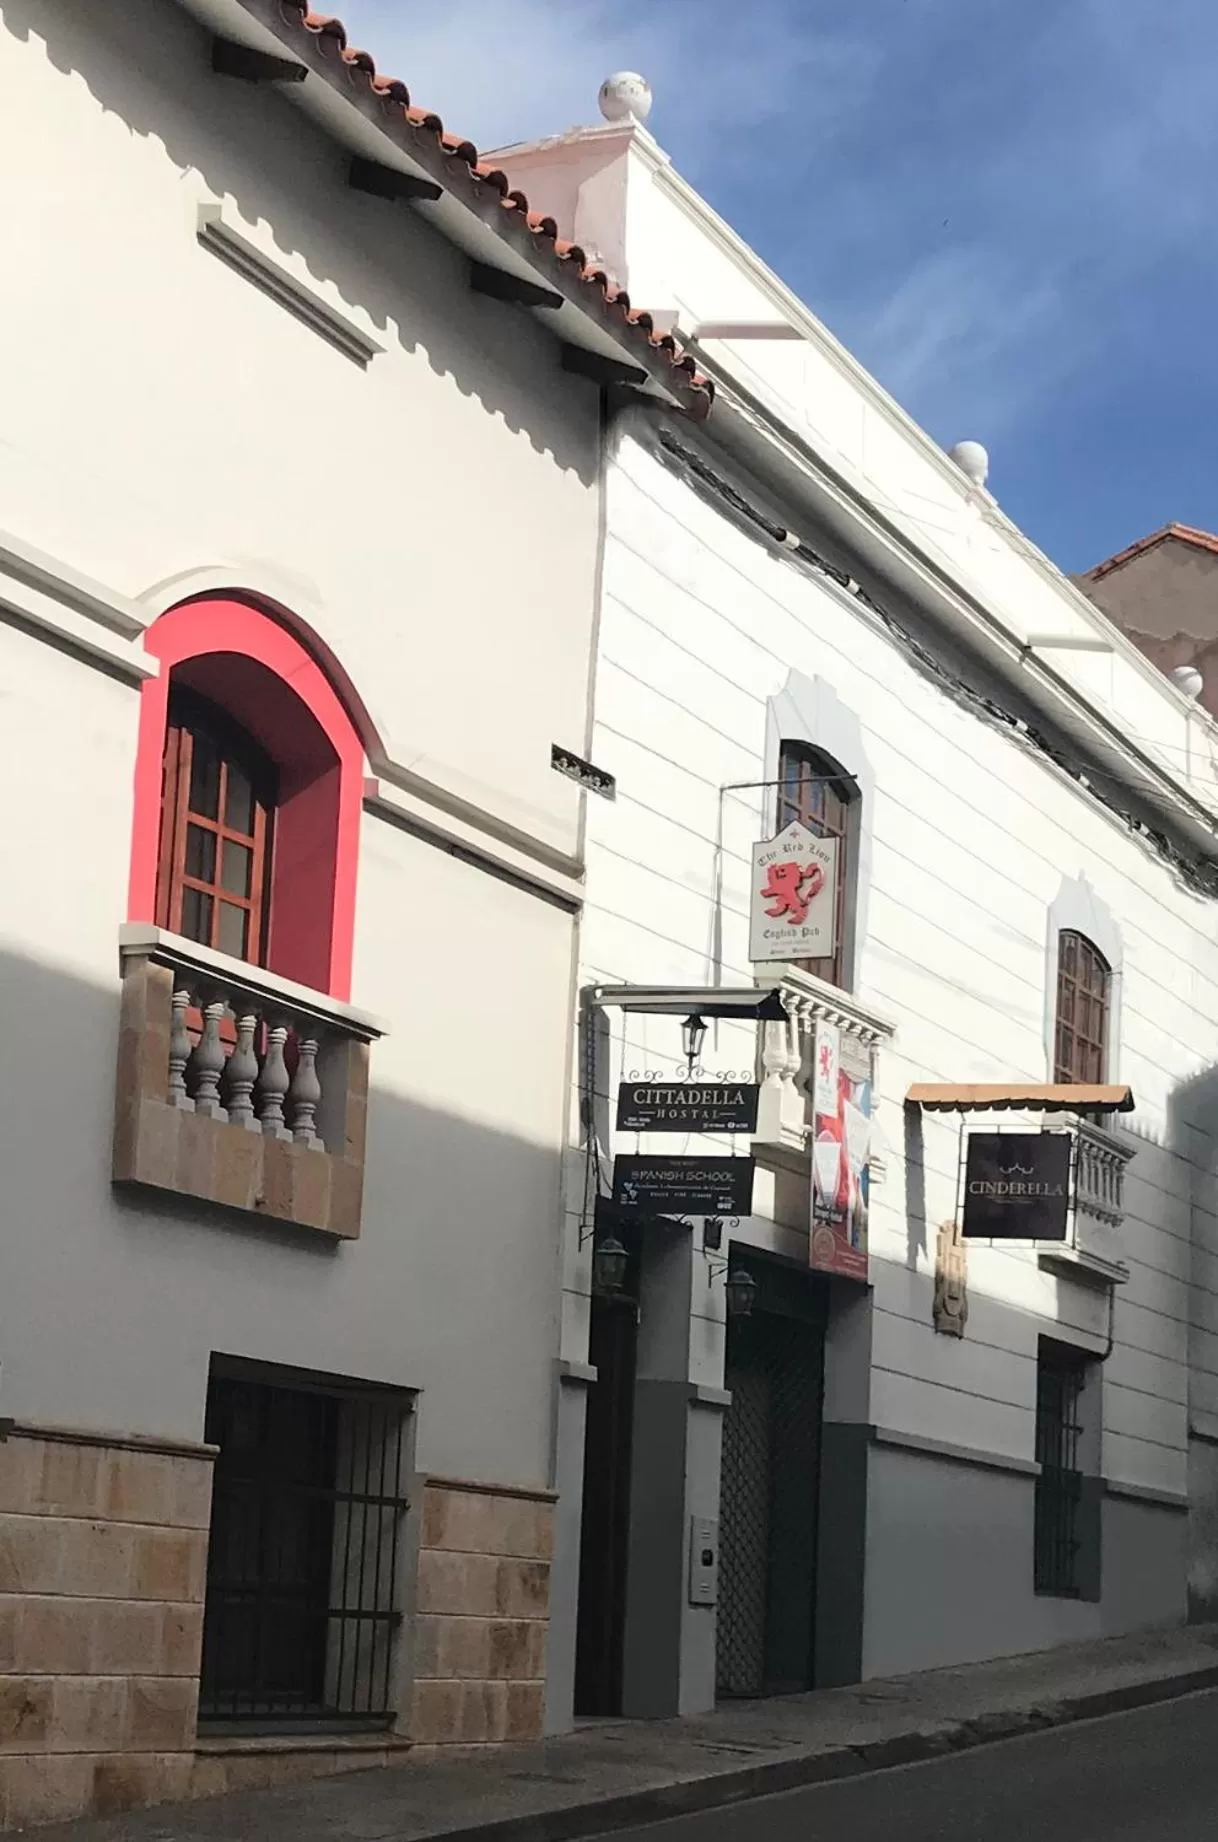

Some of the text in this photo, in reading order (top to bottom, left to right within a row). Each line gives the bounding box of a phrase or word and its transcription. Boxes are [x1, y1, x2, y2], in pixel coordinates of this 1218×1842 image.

[758, 842, 831, 867] The Red Lion
[763, 927, 820, 940] English Pub
[632, 1088, 745, 1105] CITTADELLA
[656, 1108, 720, 1119] HOSTAL
[631, 1170, 684, 1181] SPANISH
[969, 1181, 1063, 1197] CINDERELLA
